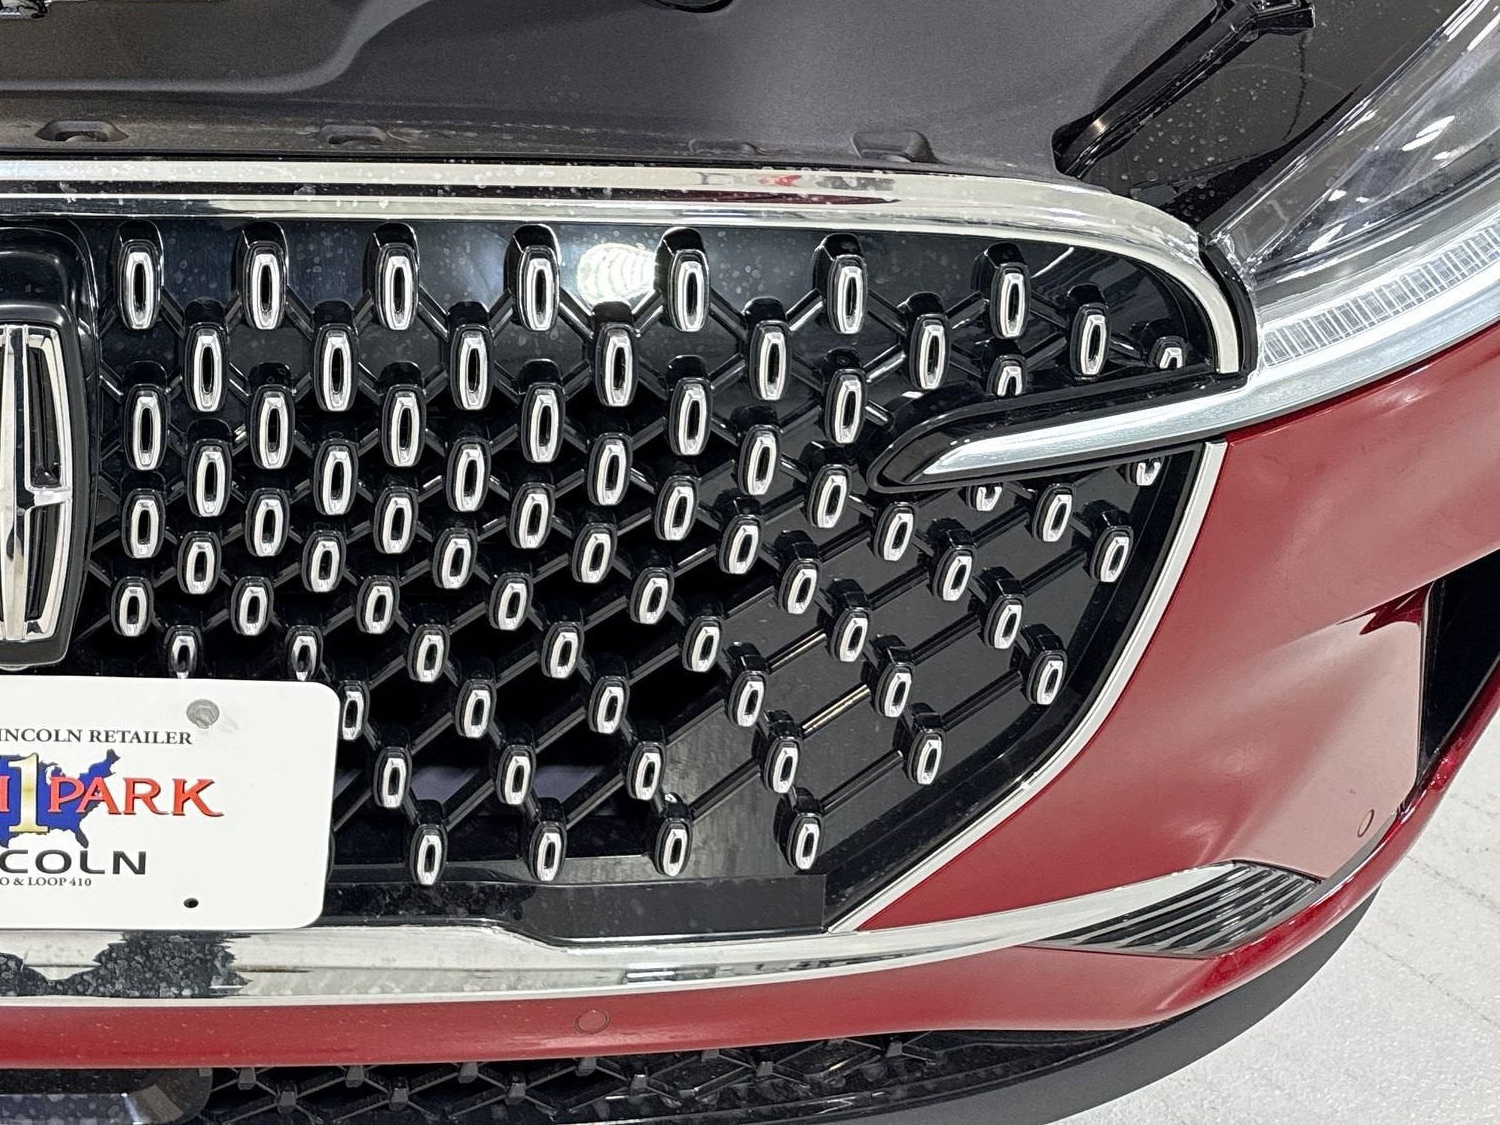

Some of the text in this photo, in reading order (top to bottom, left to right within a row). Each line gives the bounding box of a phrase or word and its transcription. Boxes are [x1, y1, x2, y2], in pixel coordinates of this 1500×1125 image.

[89, 729, 193, 745] RETAILER
[48, 776, 225, 817] PARK
[13, 877, 25, 886] &
[28, 877, 67, 886] LOOP
[69, 877, 92, 887] 410
